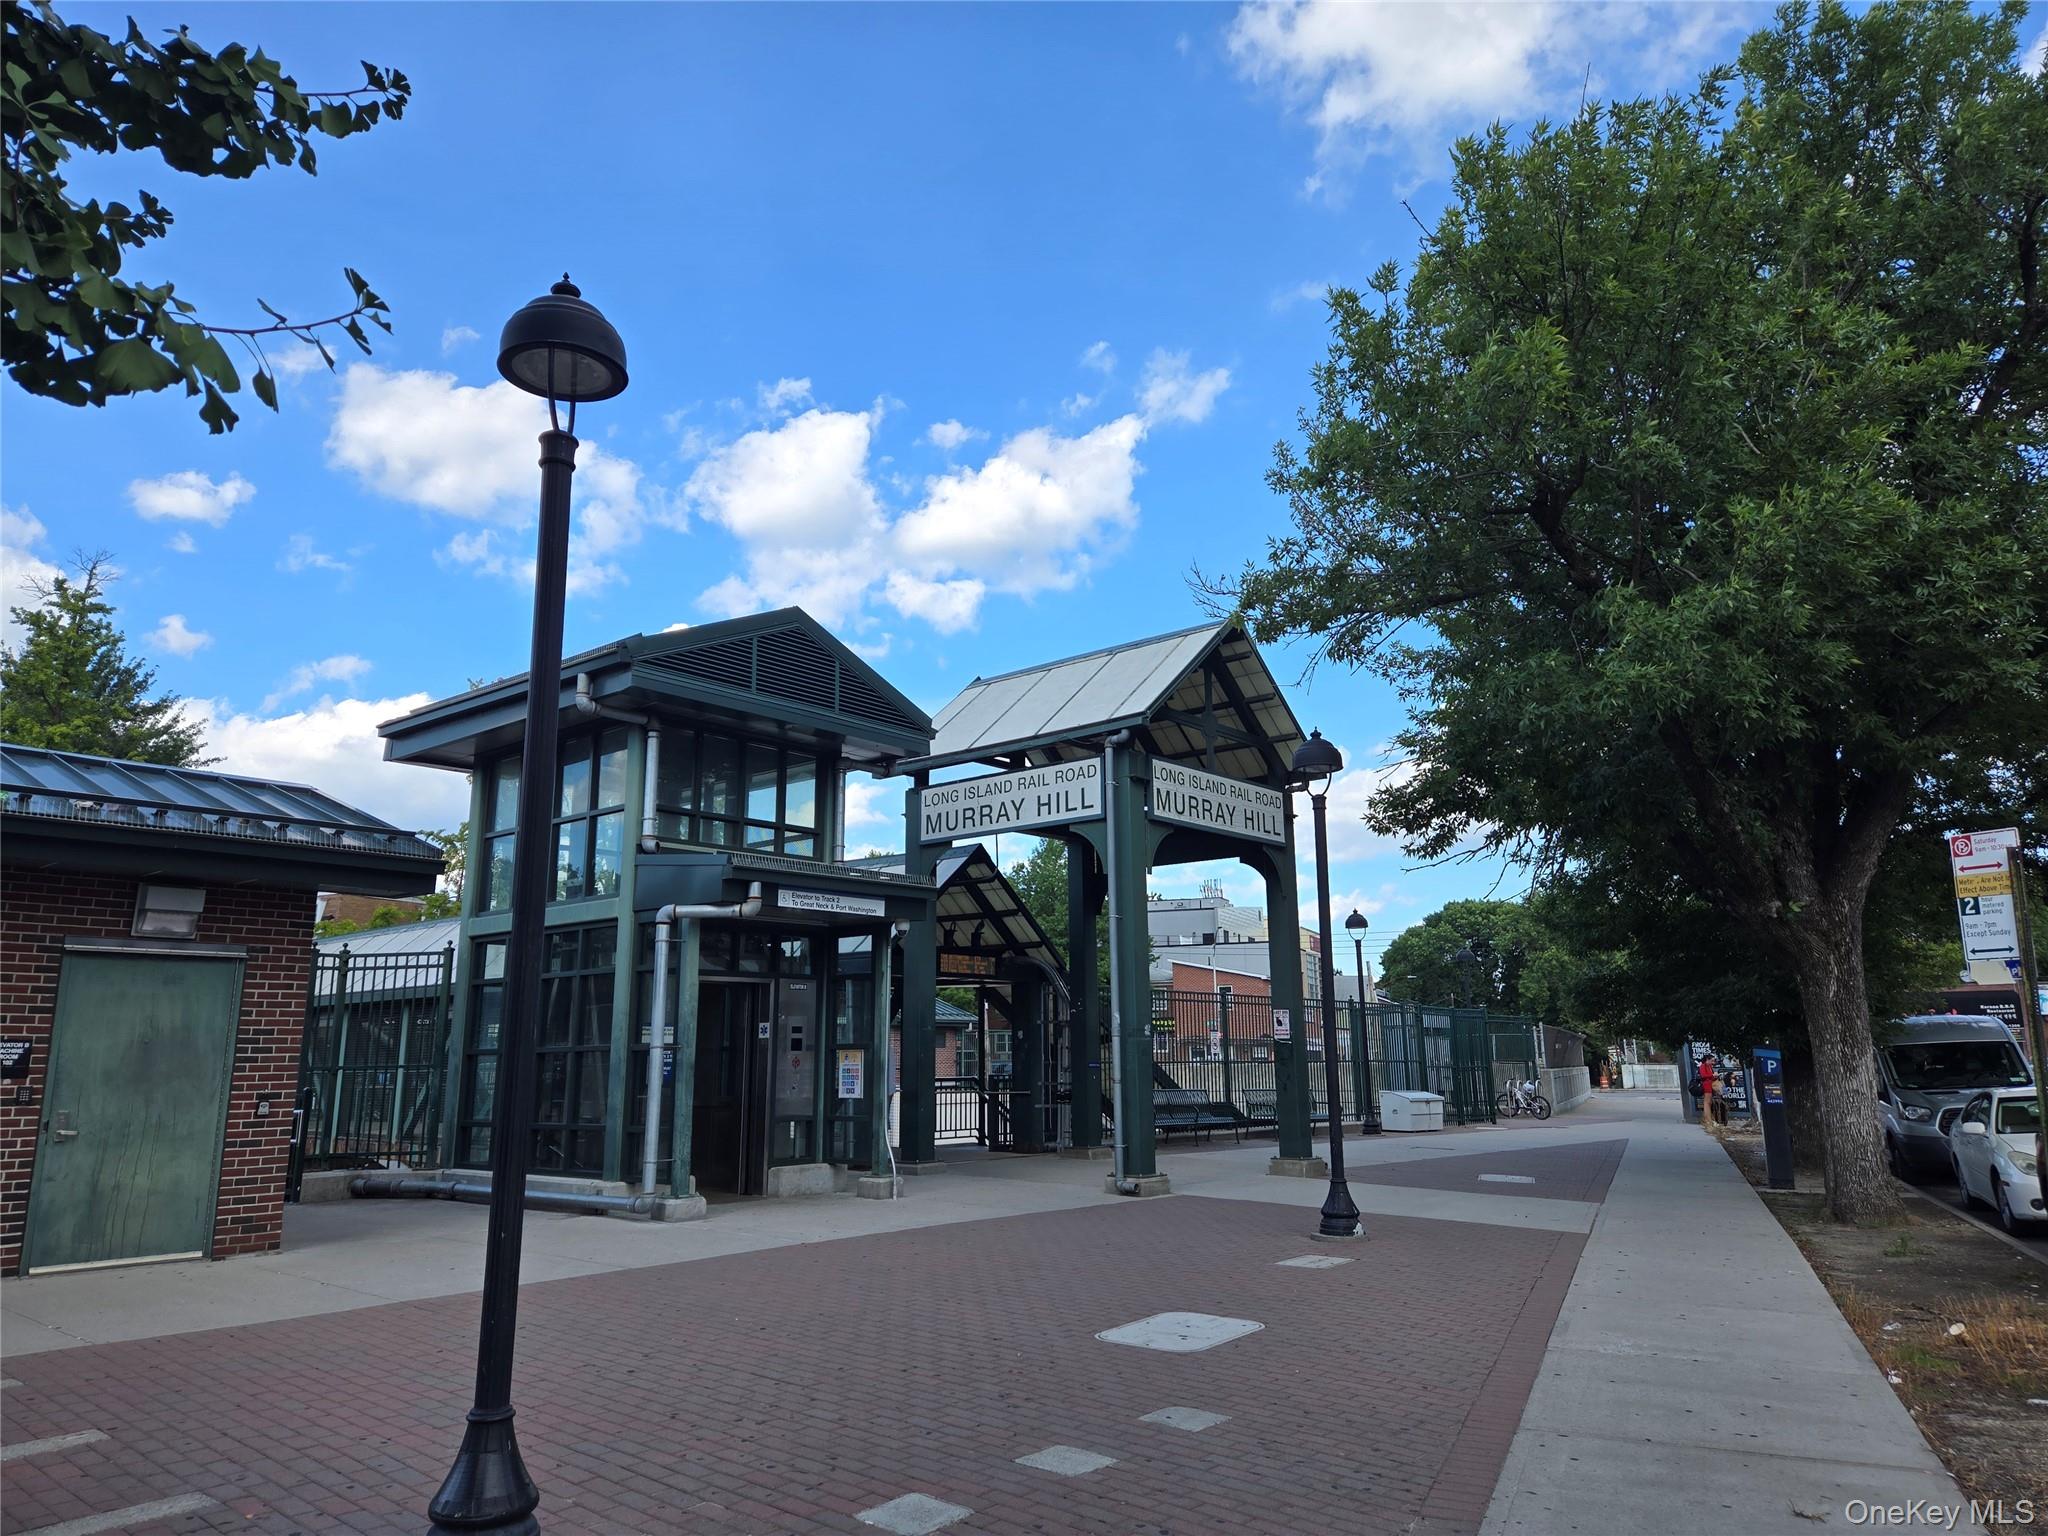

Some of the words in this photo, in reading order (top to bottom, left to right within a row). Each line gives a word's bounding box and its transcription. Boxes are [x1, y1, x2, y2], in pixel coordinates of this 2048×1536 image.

[924, 790, 959, 807] LONG
[964, 780, 1013, 800] ISLAND
[1017, 773, 1050, 791] RAIL
[1055, 764, 1097, 784] ROAD
[1154, 765, 1185, 786] LONG
[1189, 774, 1227, 796] ISLAND
[1230, 784, 1252, 803] RAIL
[1255, 791, 1281, 809] ROAD
[925, 797, 1025, 835] MURRAY
[1037, 787, 1094, 817] HILL
[1156, 788, 1236, 826] MURRAY
[1244, 808, 1281, 836] HILL
[1973, 837, 1997, 845] Saturday
[1992, 874, 2004, 883] Not
[1960, 887, 1978, 895] Effect
[1980, 884, 1997, 893] Above
[791, 891, 813, 901] Elevator
[821, 895, 836, 903] Track
[836, 896, 841, 904] 2
[816, 902, 829, 910] Neck
[848, 905, 877, 914] Washington
[1963, 897, 1976, 915] 2
[1982, 908, 2003, 916] parking
[1965, 922, 1979, 930] 9am
[1983, 921, 1997, 929] 7pm
[1966, 929, 1988, 938] Except
[1988, 928, 2012, 937] Sunday
[1767, 1060, 1777, 1073] P
